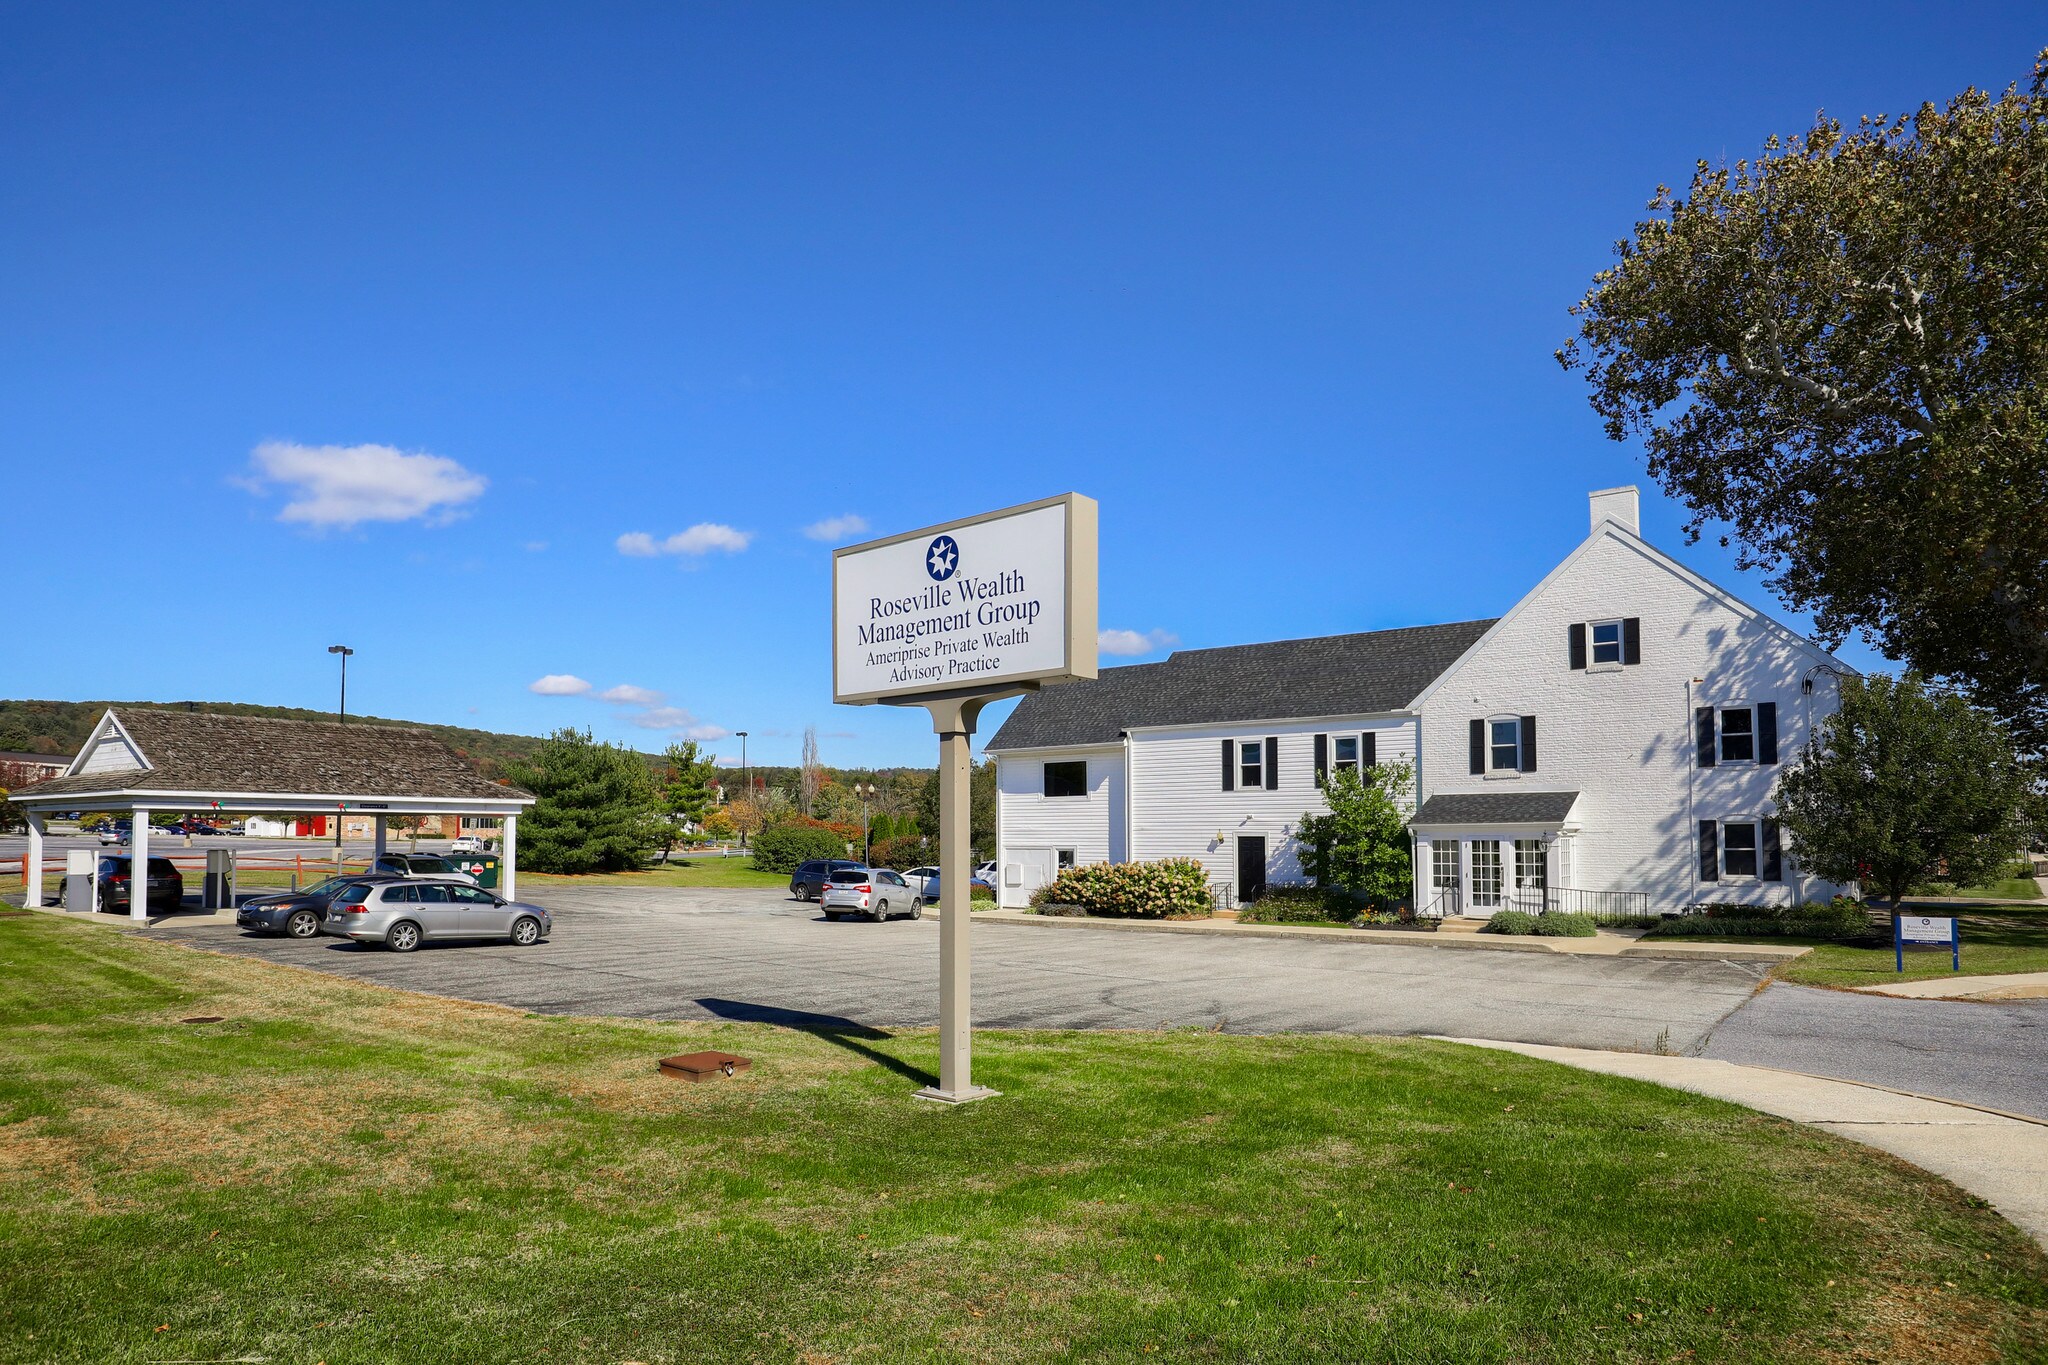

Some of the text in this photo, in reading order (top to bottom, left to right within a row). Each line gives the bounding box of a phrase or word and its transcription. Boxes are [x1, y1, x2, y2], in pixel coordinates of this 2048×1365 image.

[870, 569, 1025, 619] Roseville Wealth
[857, 599, 1041, 645] Management Group
[866, 627, 1029, 667] Ameriprise Private Wealth
[889, 654, 1000, 683] Advisory Practice
